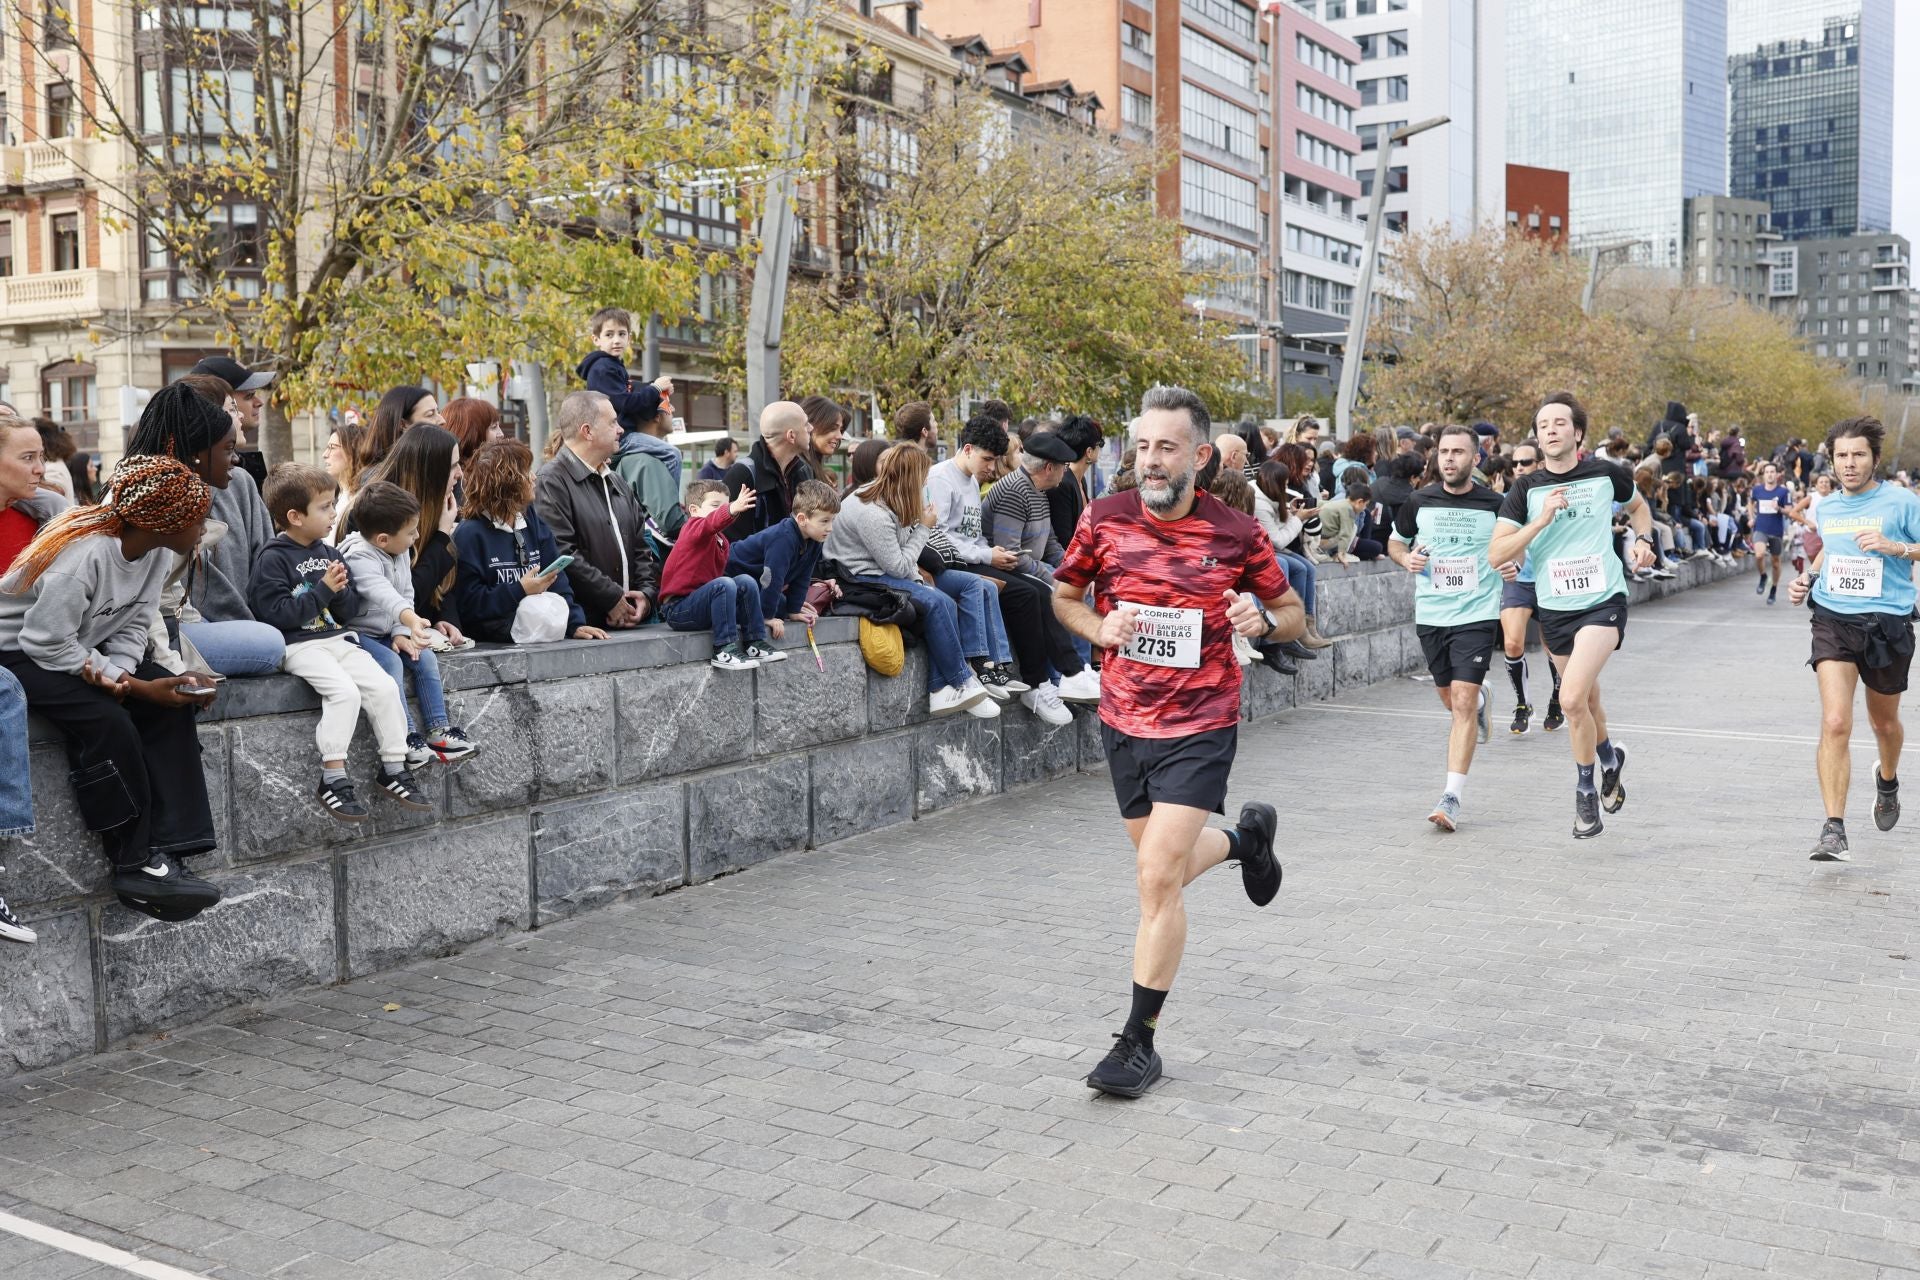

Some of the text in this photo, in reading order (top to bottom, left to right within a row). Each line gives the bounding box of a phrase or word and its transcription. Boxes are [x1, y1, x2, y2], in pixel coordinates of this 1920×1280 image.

[1434, 567, 1453, 575] XXXVI
[1553, 569, 1575, 578] XXXVI
[1831, 566, 1851, 575] XXXVI
[1446, 575, 1463, 586] 308
[1565, 577, 1590, 590] 1131
[1839, 577, 1865, 590] 2625
[1144, 610, 1182, 619] CORREO
[1134, 620, 1154, 635] XVI
[1156, 629, 1192, 638] BILBAO
[1137, 636, 1176, 658] 2735
